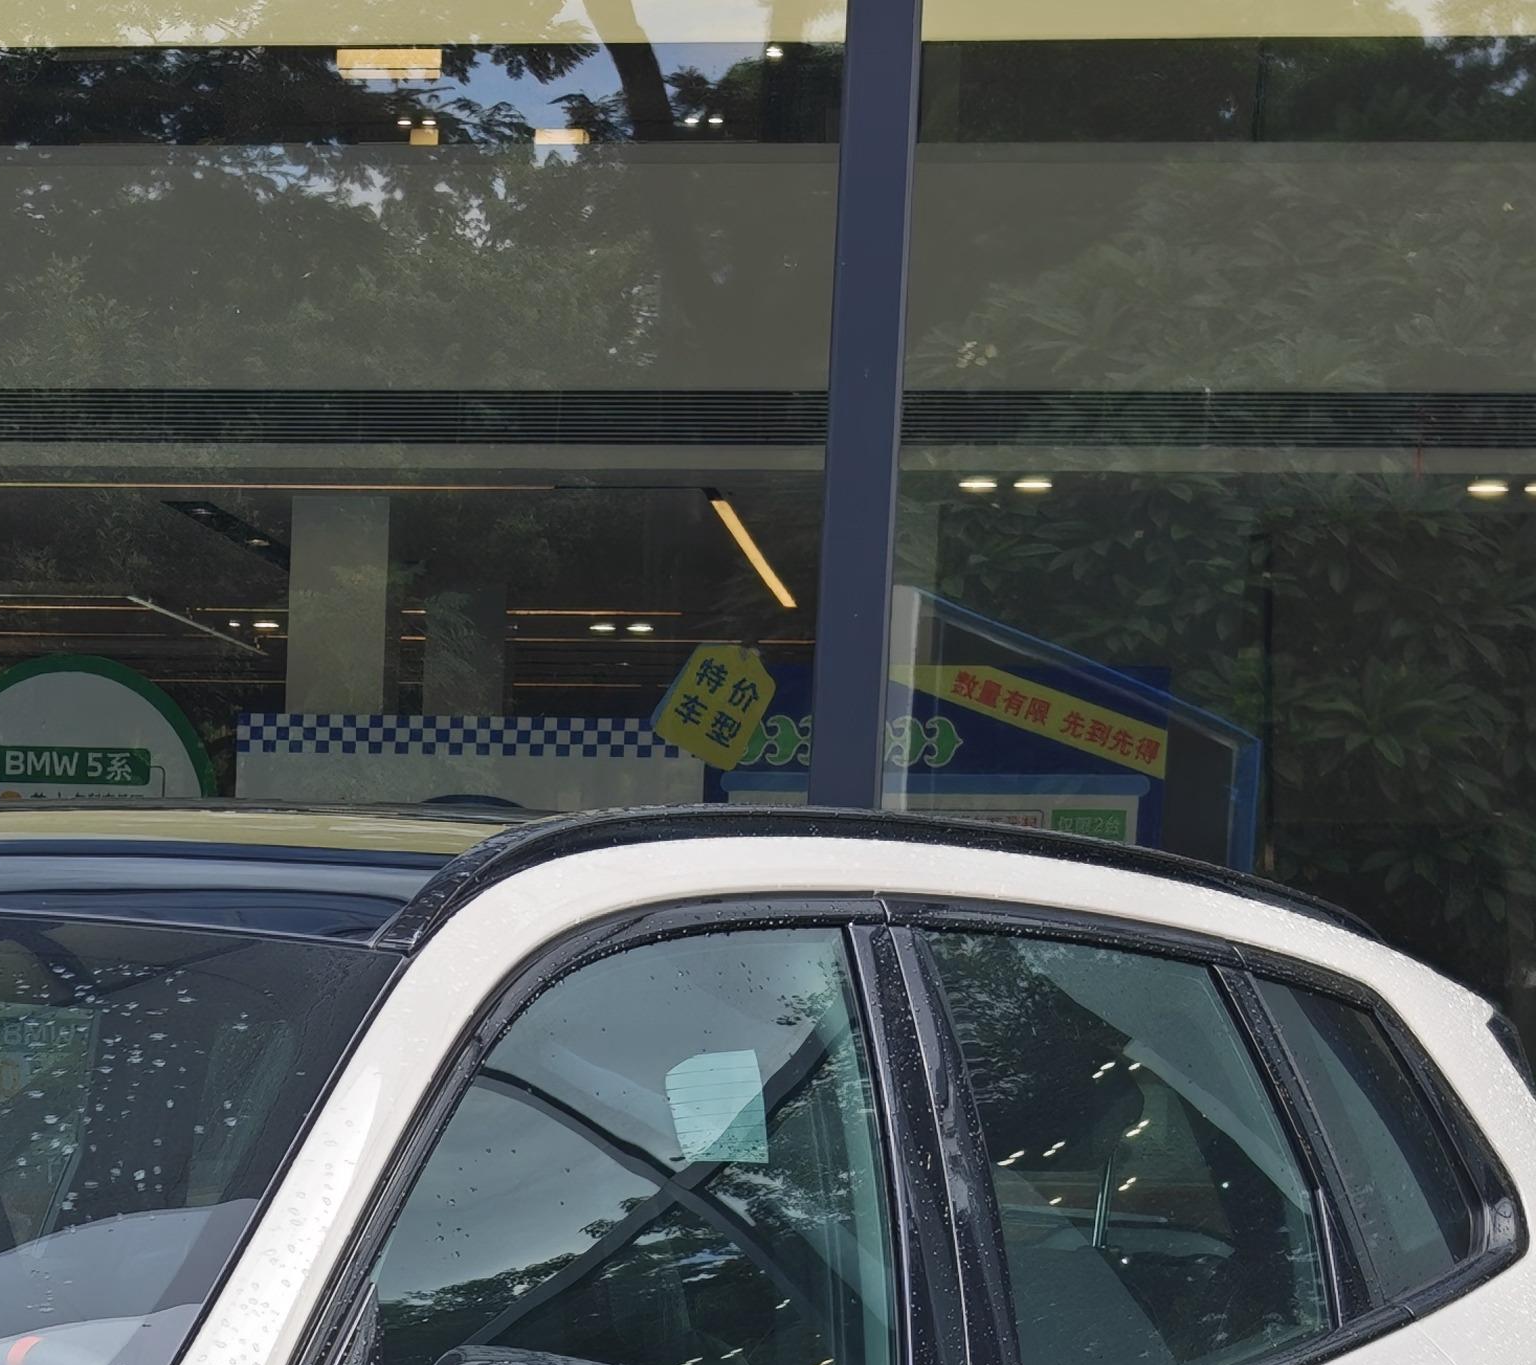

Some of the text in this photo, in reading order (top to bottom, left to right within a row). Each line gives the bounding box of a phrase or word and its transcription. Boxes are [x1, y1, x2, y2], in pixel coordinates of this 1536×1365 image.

[696, 658, 758, 712] 特价
[674, 694, 742, 748] 车型
[951, 670, 1161, 764] 数量有限 先到先得
[5, 751, 132, 781] BMW 5系
